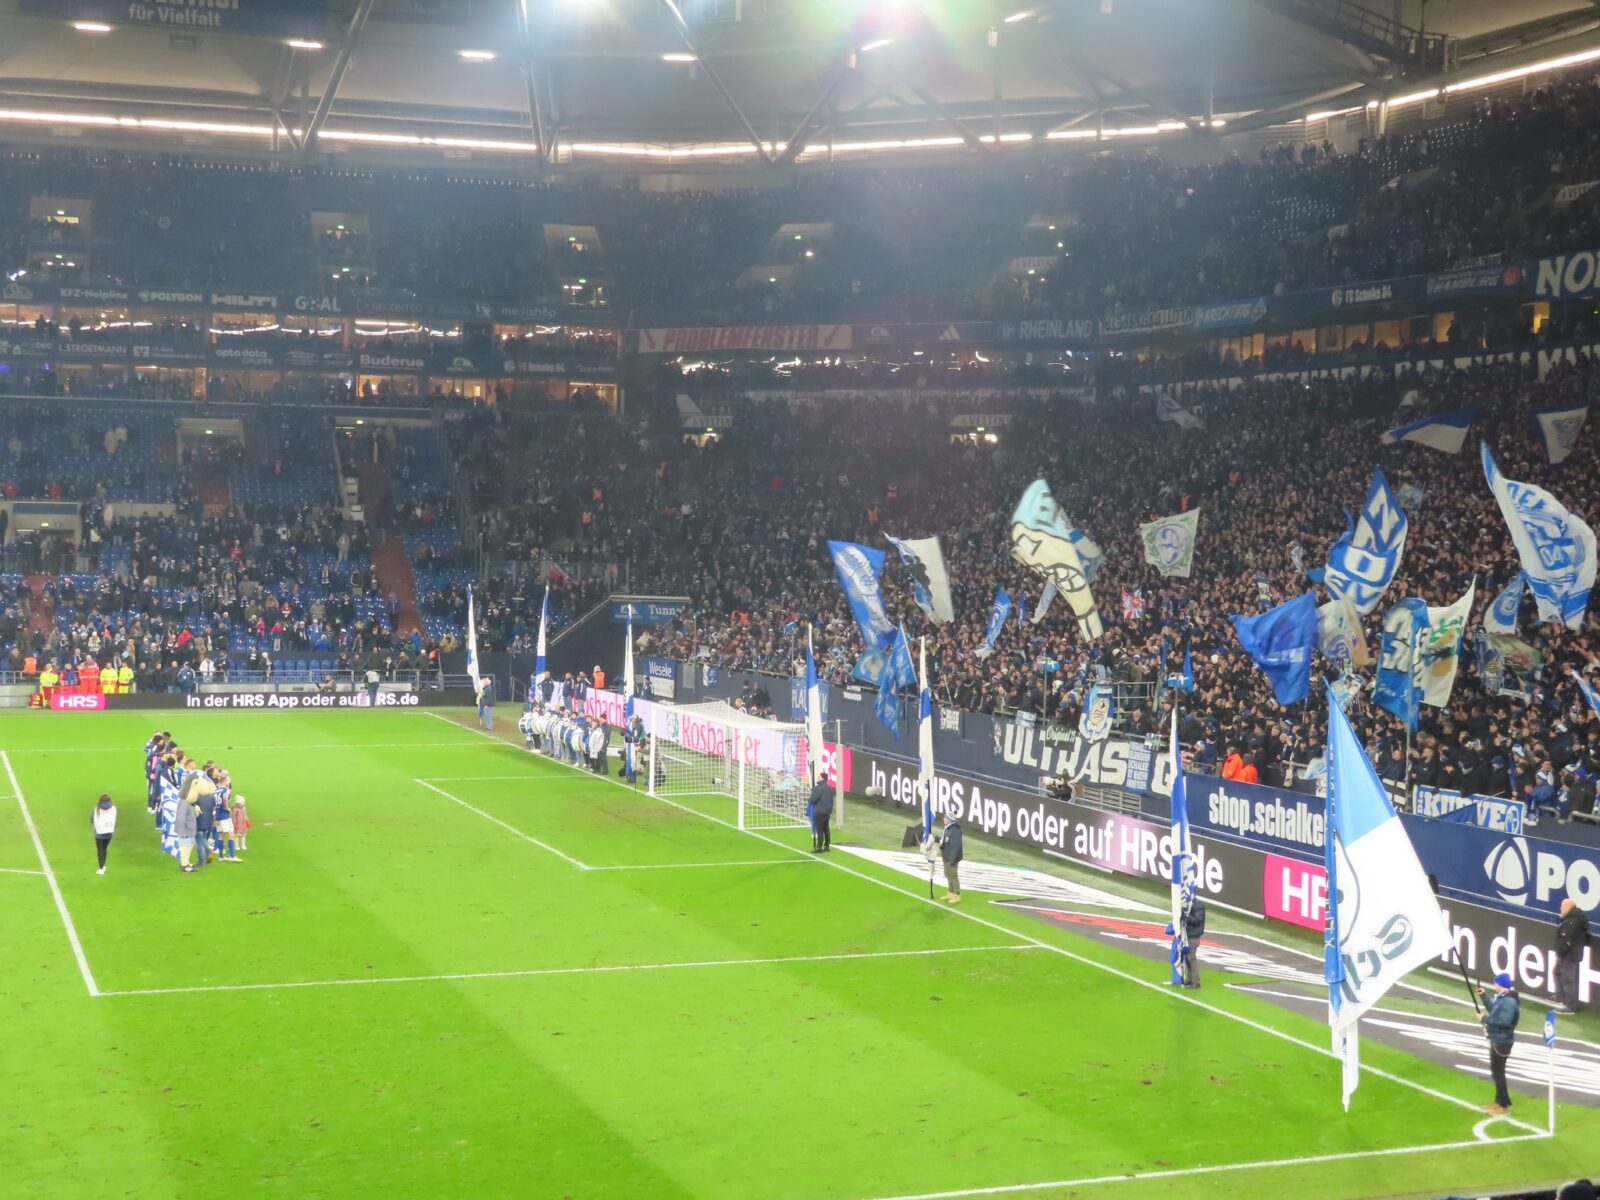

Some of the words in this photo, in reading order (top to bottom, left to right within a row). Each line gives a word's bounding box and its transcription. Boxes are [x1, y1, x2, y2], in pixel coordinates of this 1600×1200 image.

[128, 4, 154, 21] für
[159, 7, 221, 27] Vielfalt
[60, 287, 128, 300] KFZ-Helpline
[150, 291, 202, 302] POLYGON
[211, 294, 277, 306] HILTI
[1019, 319, 1093, 339] RHEINLAND
[359, 354, 424, 367] Buderus
[59, 695, 98, 708] HRS
[187, 694, 200, 706] In
[204, 693, 229, 707] der
[232, 694, 264, 707] HRS
[267, 694, 298, 709] App
[302, 693, 336, 706] oder
[339, 692, 362, 706] auf
[1208, 786, 1327, 848] shop.schalke
[872, 761, 886, 797] In
[890, 767, 921, 806] der
[967, 786, 1012, 837] App
[1016, 803, 1069, 849] oder
[1074, 819, 1115, 862] auf
[1120, 824, 1224, 894] HRSde
